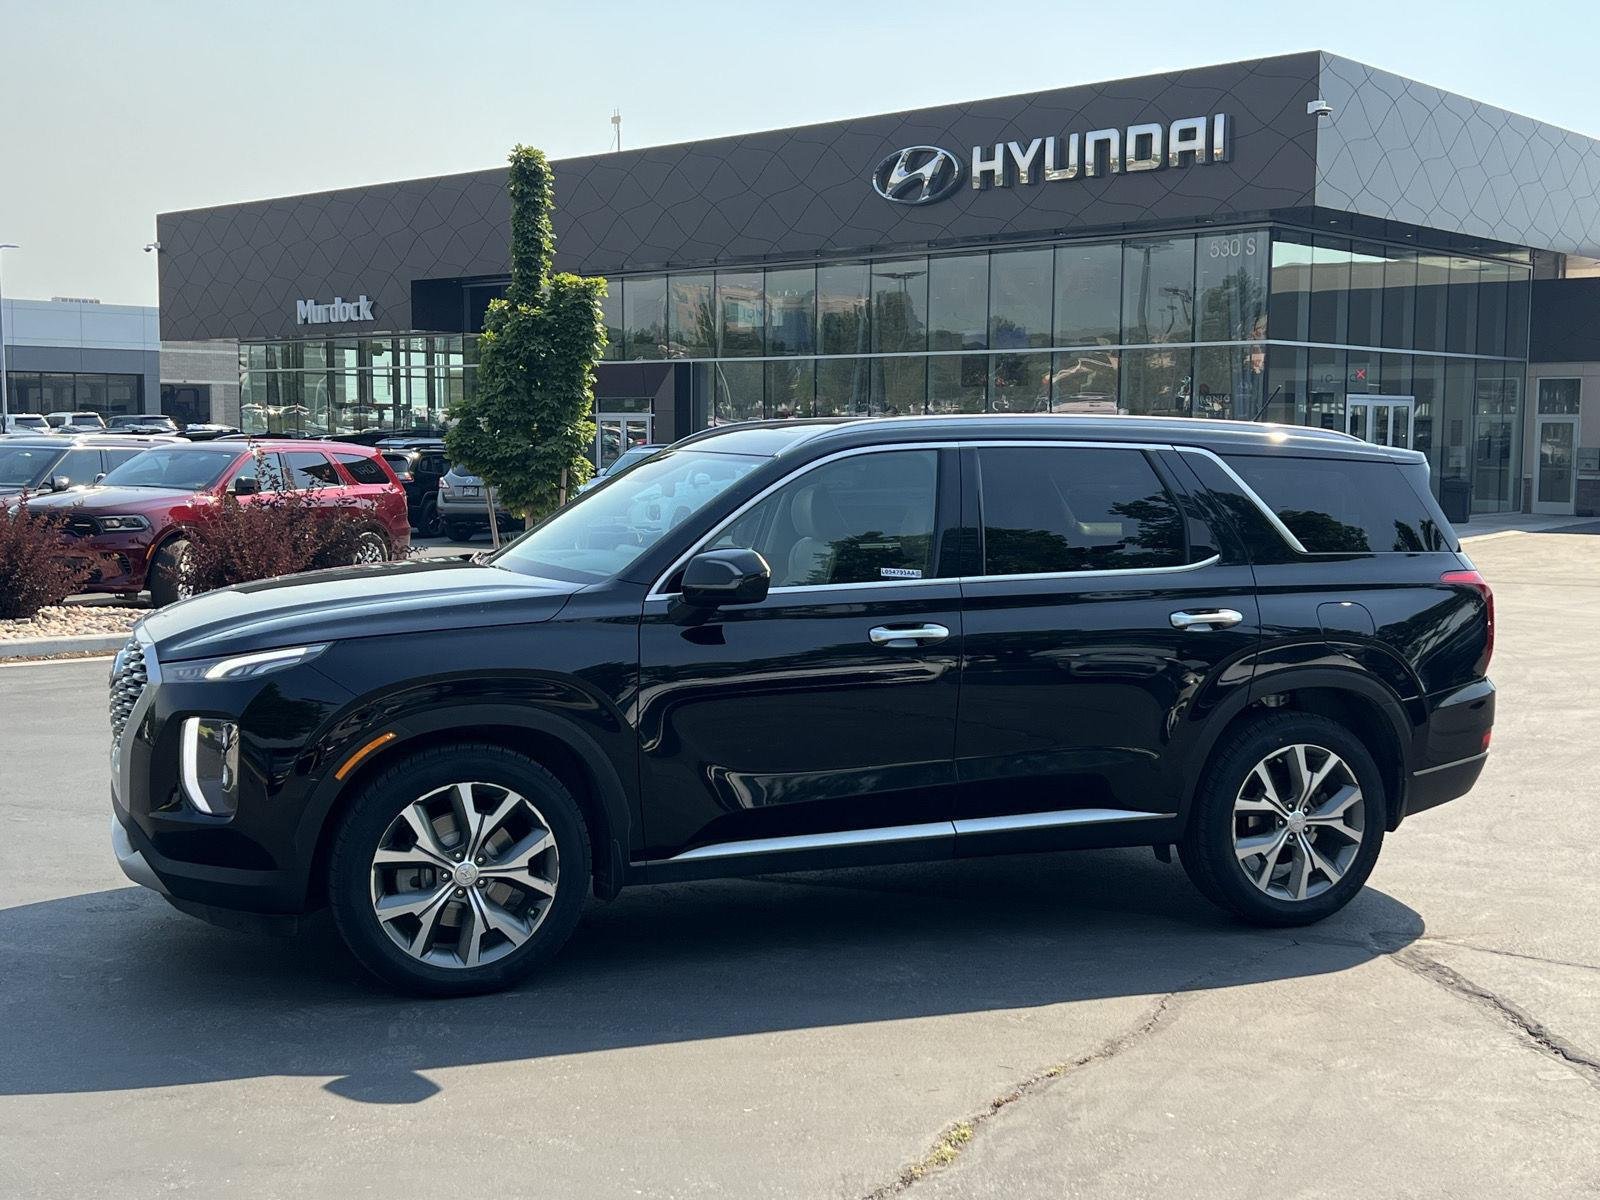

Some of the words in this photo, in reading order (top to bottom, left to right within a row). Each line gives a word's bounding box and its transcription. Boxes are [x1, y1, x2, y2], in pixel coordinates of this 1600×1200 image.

[971, 113, 1227, 190] HYUNDAI
[1209, 239, 1240, 258] 530
[1246, 237, 1256, 256] S
[296, 295, 374, 324] Murdock
